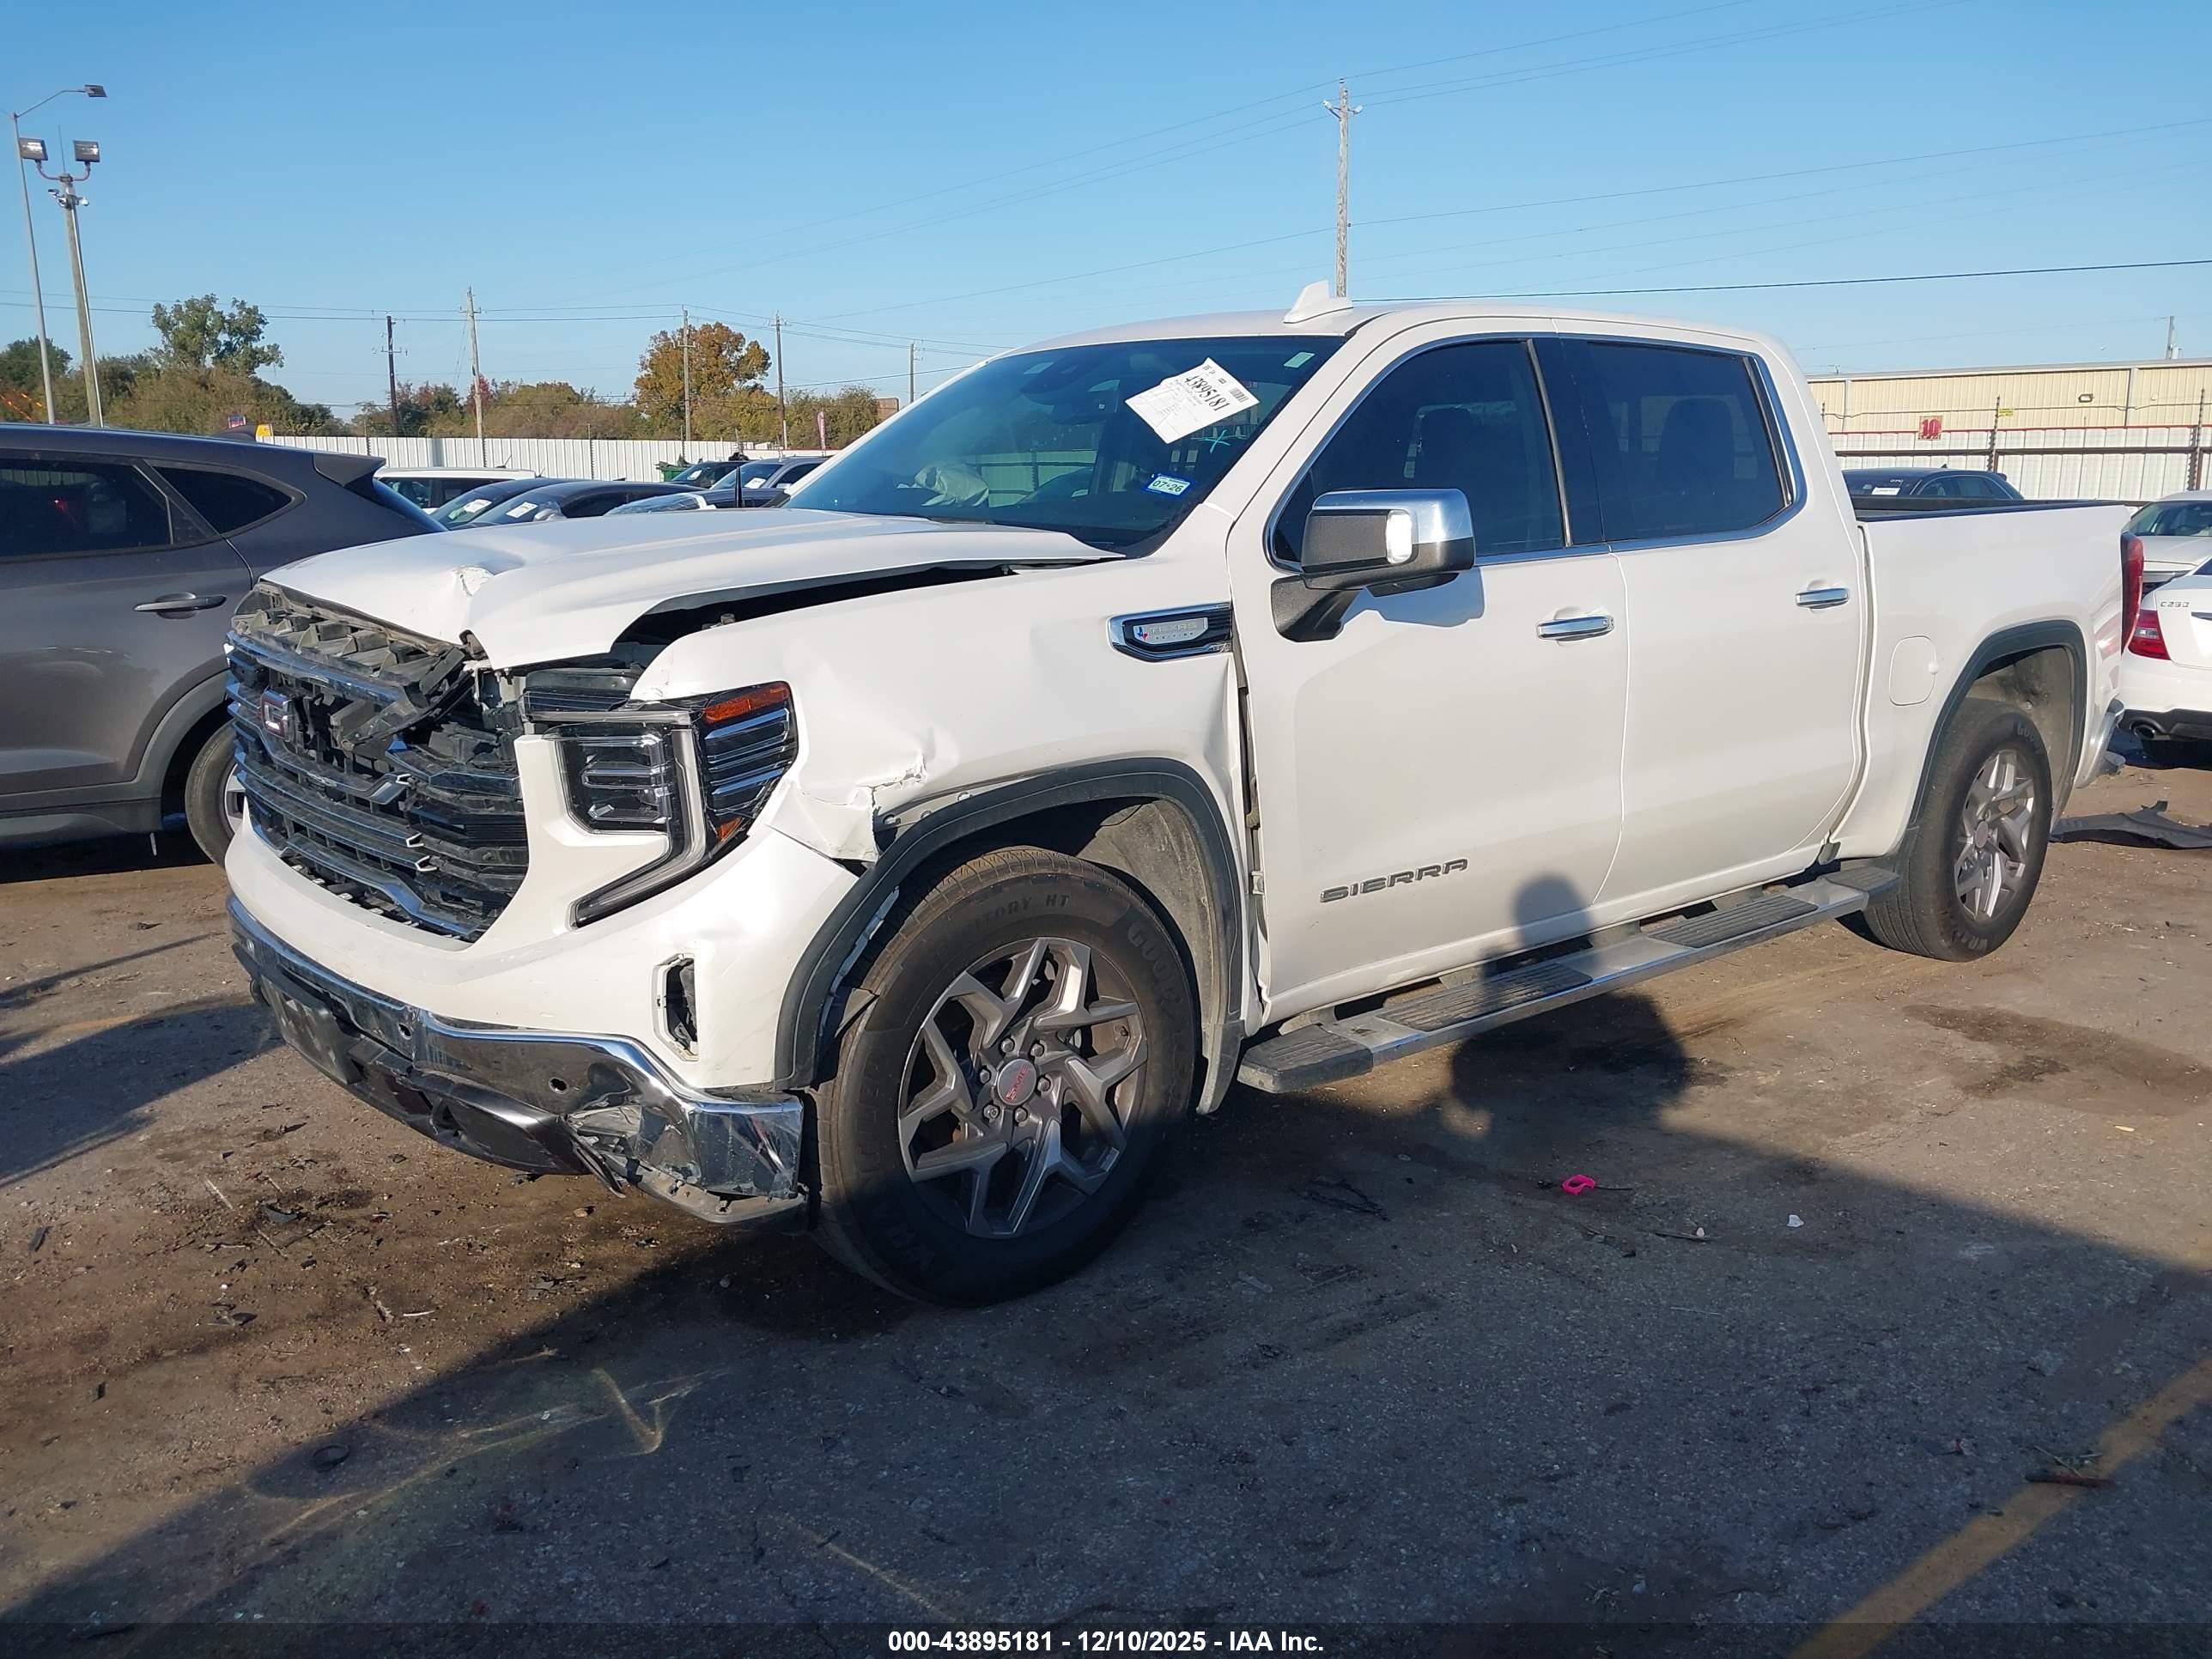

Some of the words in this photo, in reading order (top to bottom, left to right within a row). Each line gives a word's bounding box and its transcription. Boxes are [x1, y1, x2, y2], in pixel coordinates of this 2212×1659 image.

[1184, 375, 1231, 412] 43895181
[1922, 418, 1941, 437] 10
[1150, 622, 1197, 634] TEXAS
[1319, 858, 1469, 903] SIERRA
[1006, 1064, 1030, 1101] GMC
